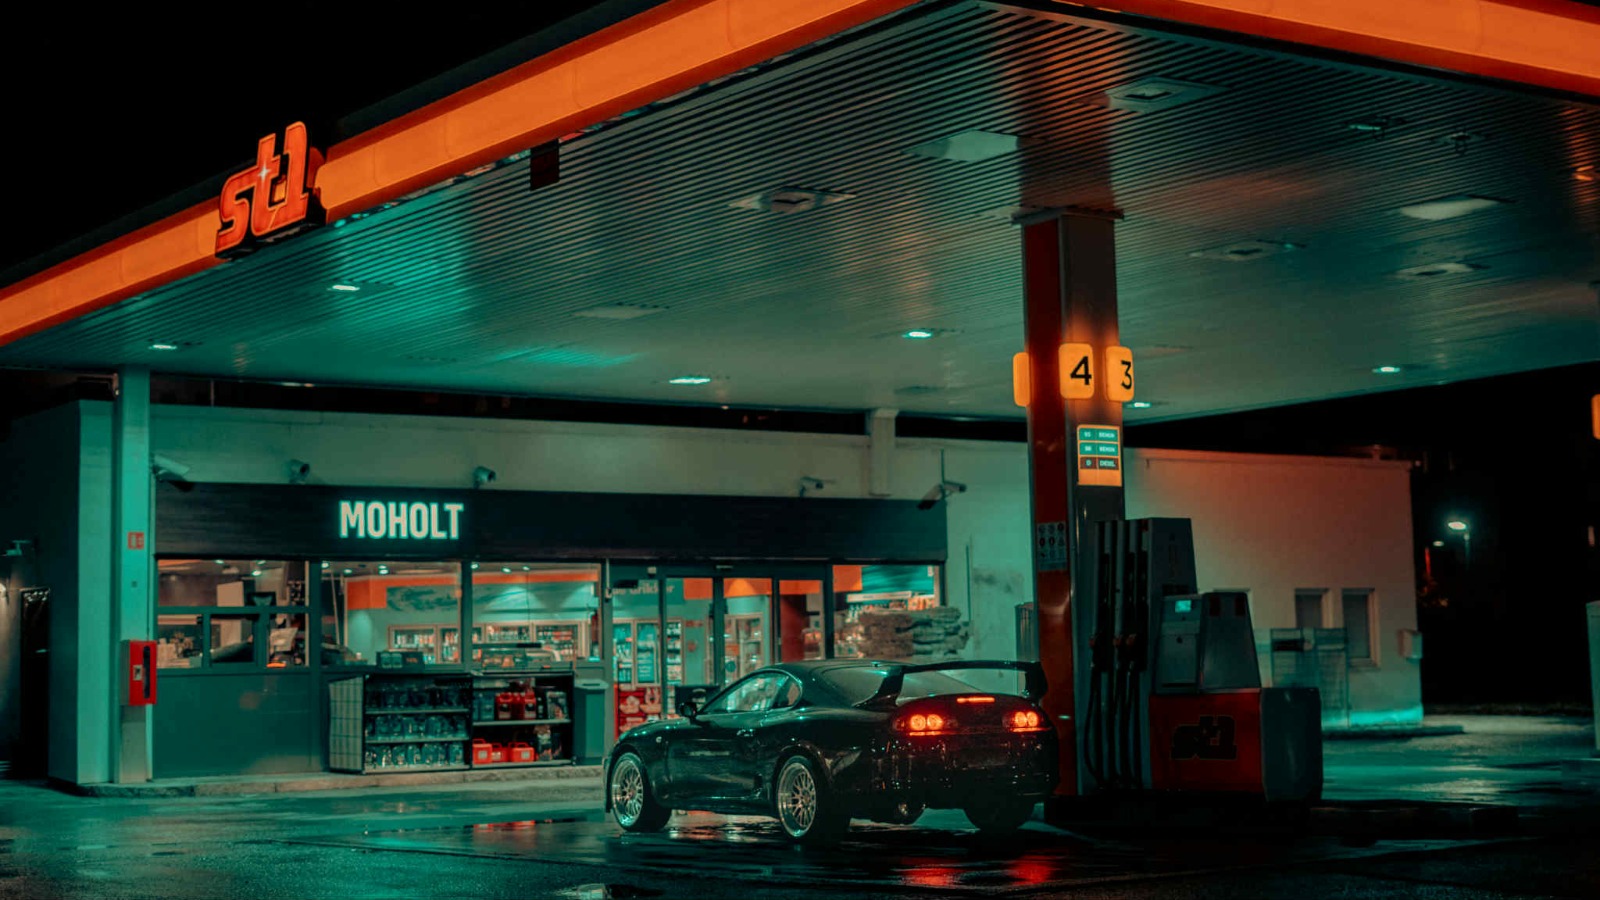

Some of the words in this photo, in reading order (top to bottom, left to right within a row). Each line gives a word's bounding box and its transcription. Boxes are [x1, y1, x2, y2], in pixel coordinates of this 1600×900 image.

[215, 120, 309, 253] st1
[1070, 356, 1092, 386] 4
[1121, 360, 1133, 390] 3
[339, 500, 464, 540] MOHOLT
